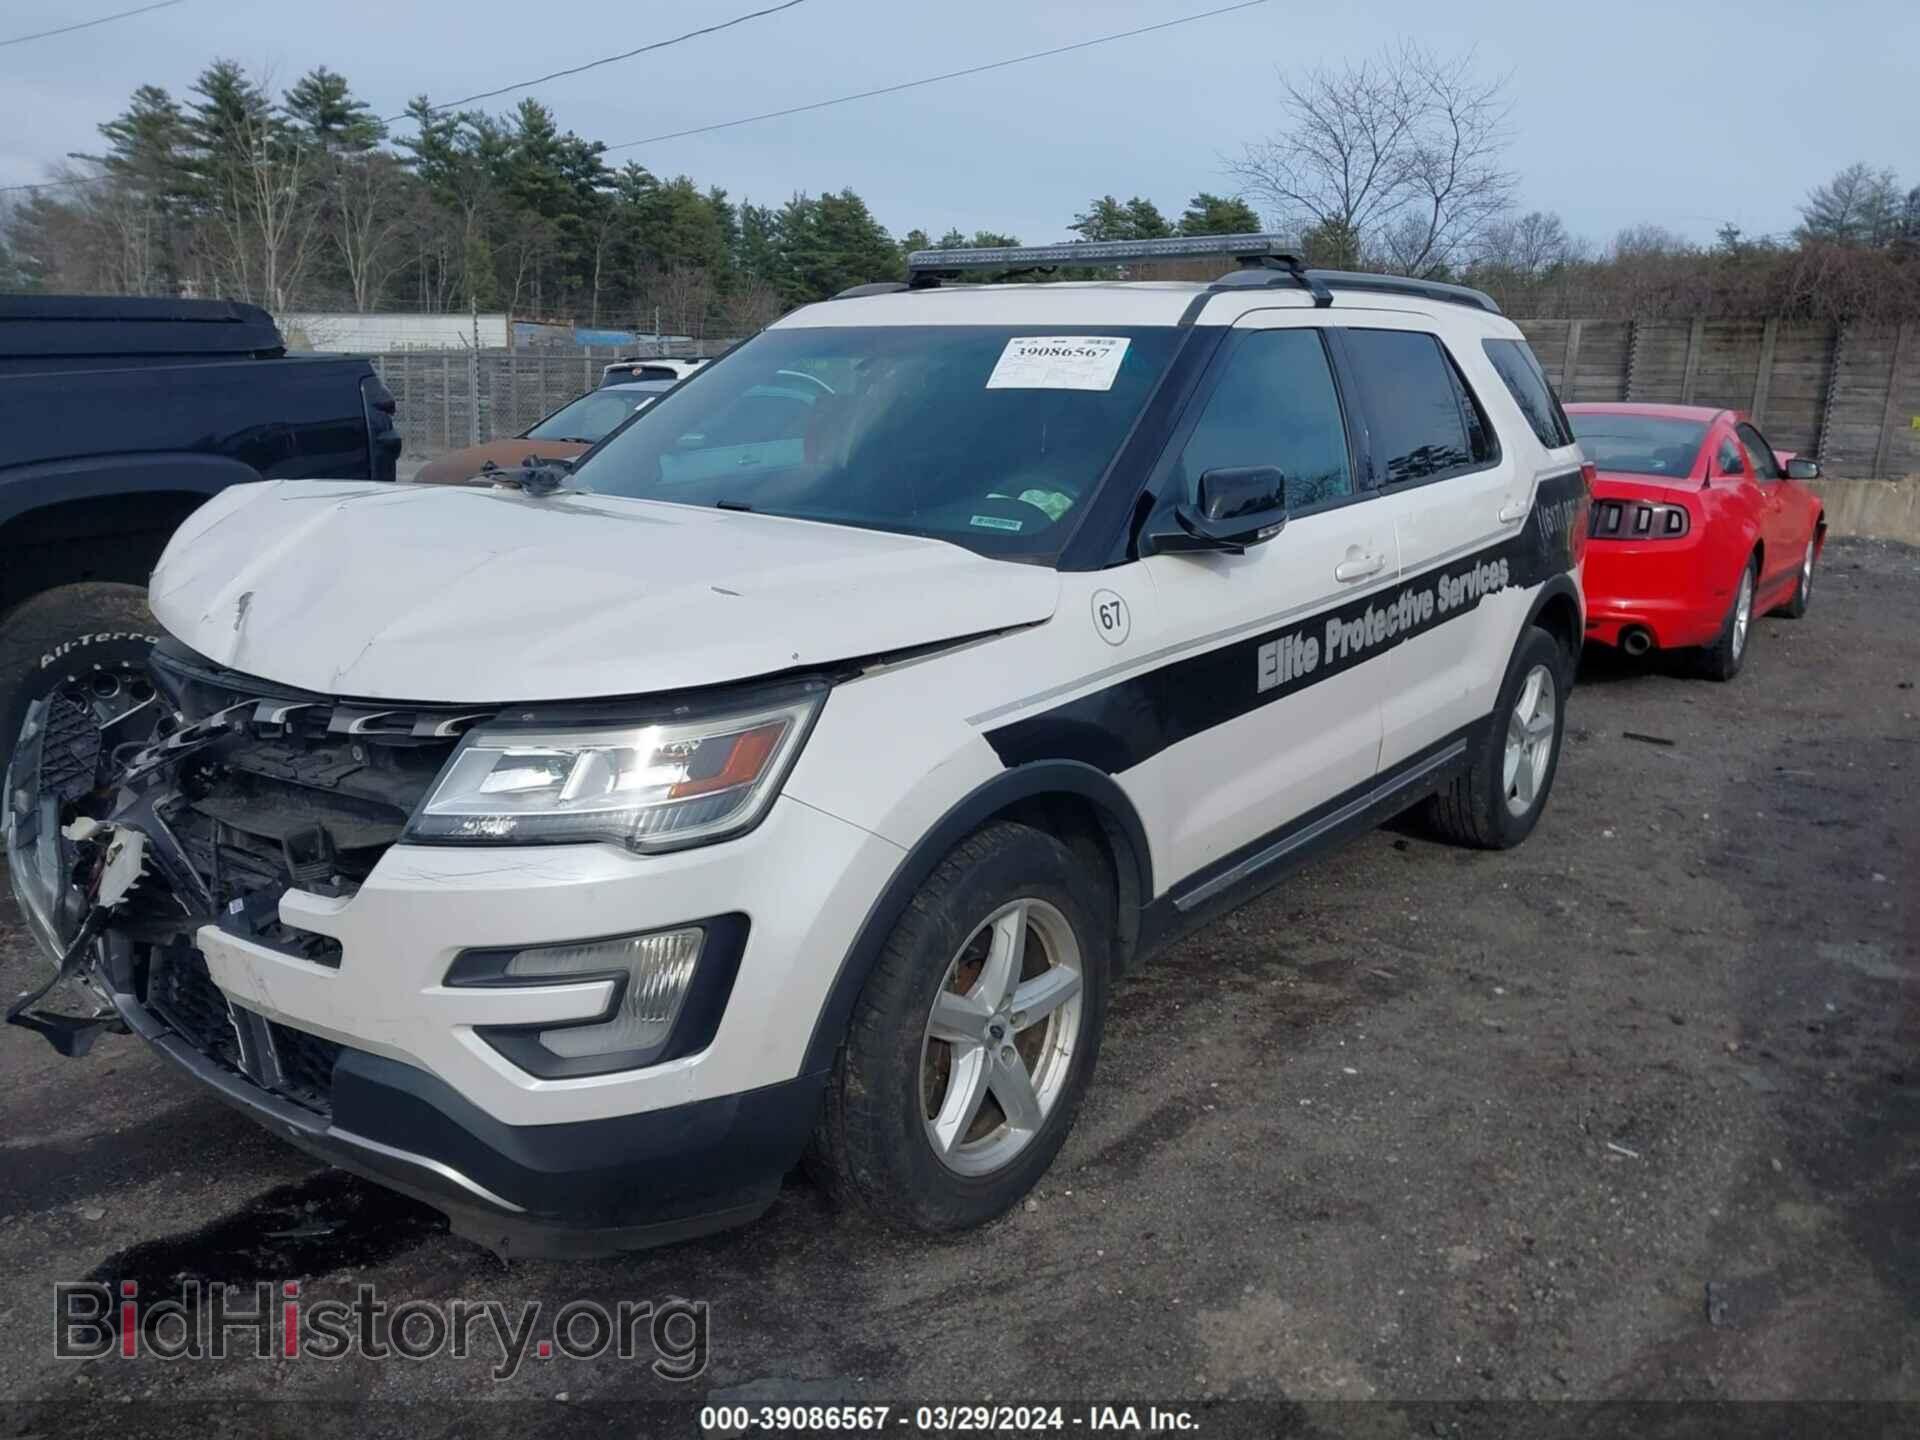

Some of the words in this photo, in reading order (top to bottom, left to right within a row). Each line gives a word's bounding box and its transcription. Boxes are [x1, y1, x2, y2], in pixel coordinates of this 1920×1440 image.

[1019, 347, 1110, 358] 39086567
[1100, 600, 1120, 630] 67
[1257, 631, 1320, 694] Elite
[1324, 588, 1435, 665] Protective
[1438, 557, 1510, 613] Services
